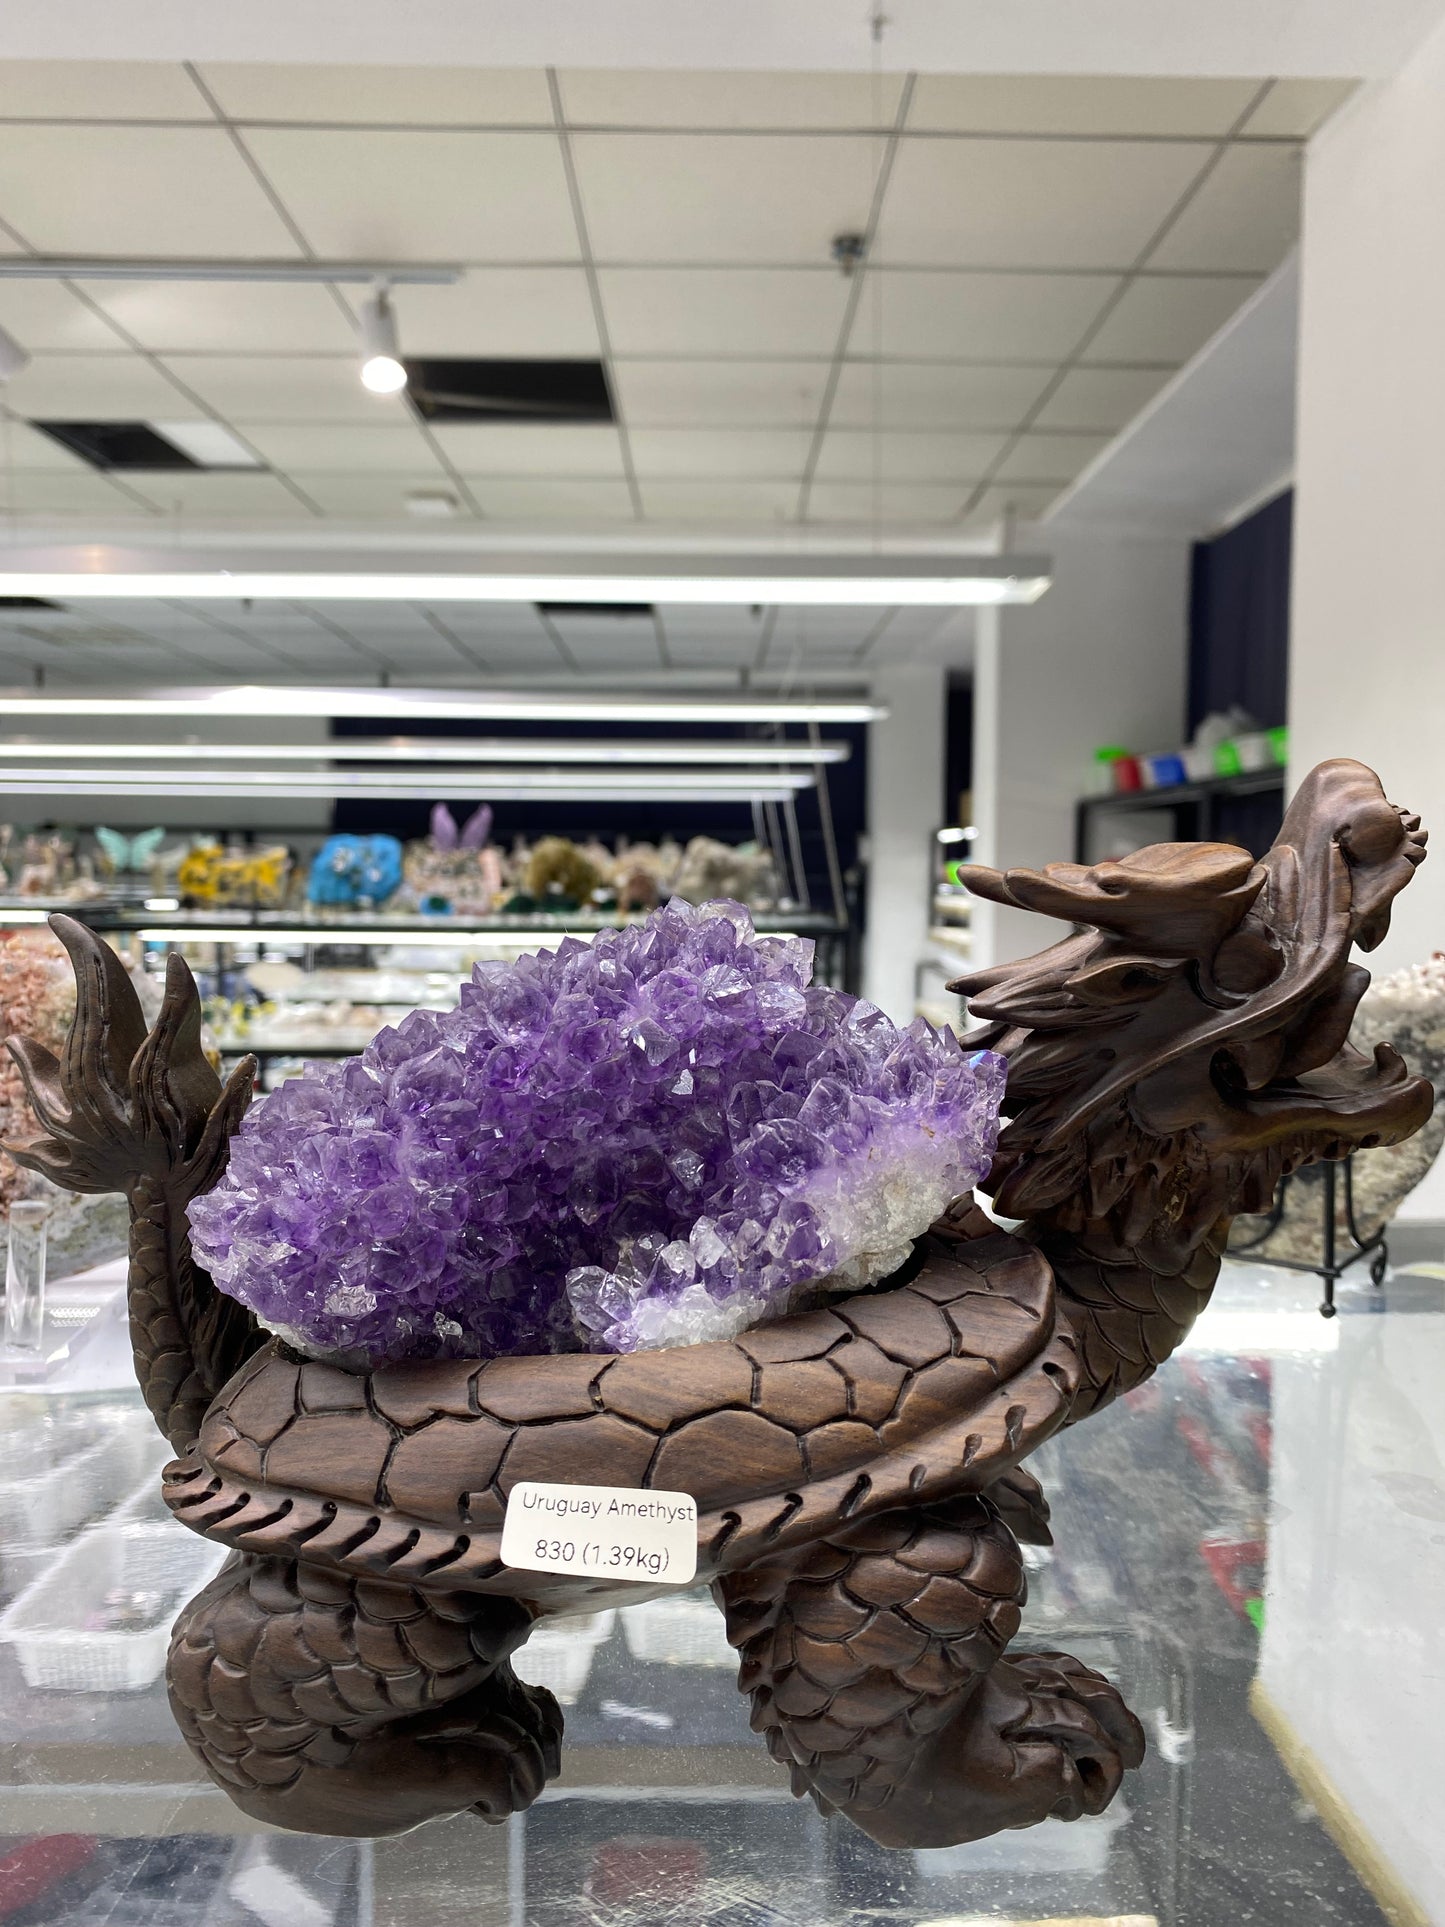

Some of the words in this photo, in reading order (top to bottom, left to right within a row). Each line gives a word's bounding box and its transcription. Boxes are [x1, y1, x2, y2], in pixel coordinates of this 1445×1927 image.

[522, 1492, 602, 1519] Uruguay
[607, 1498, 694, 1524] Amethyst
[534, 1539, 575, 1562] 830
[582, 1542, 670, 1574] (1.39kg)
